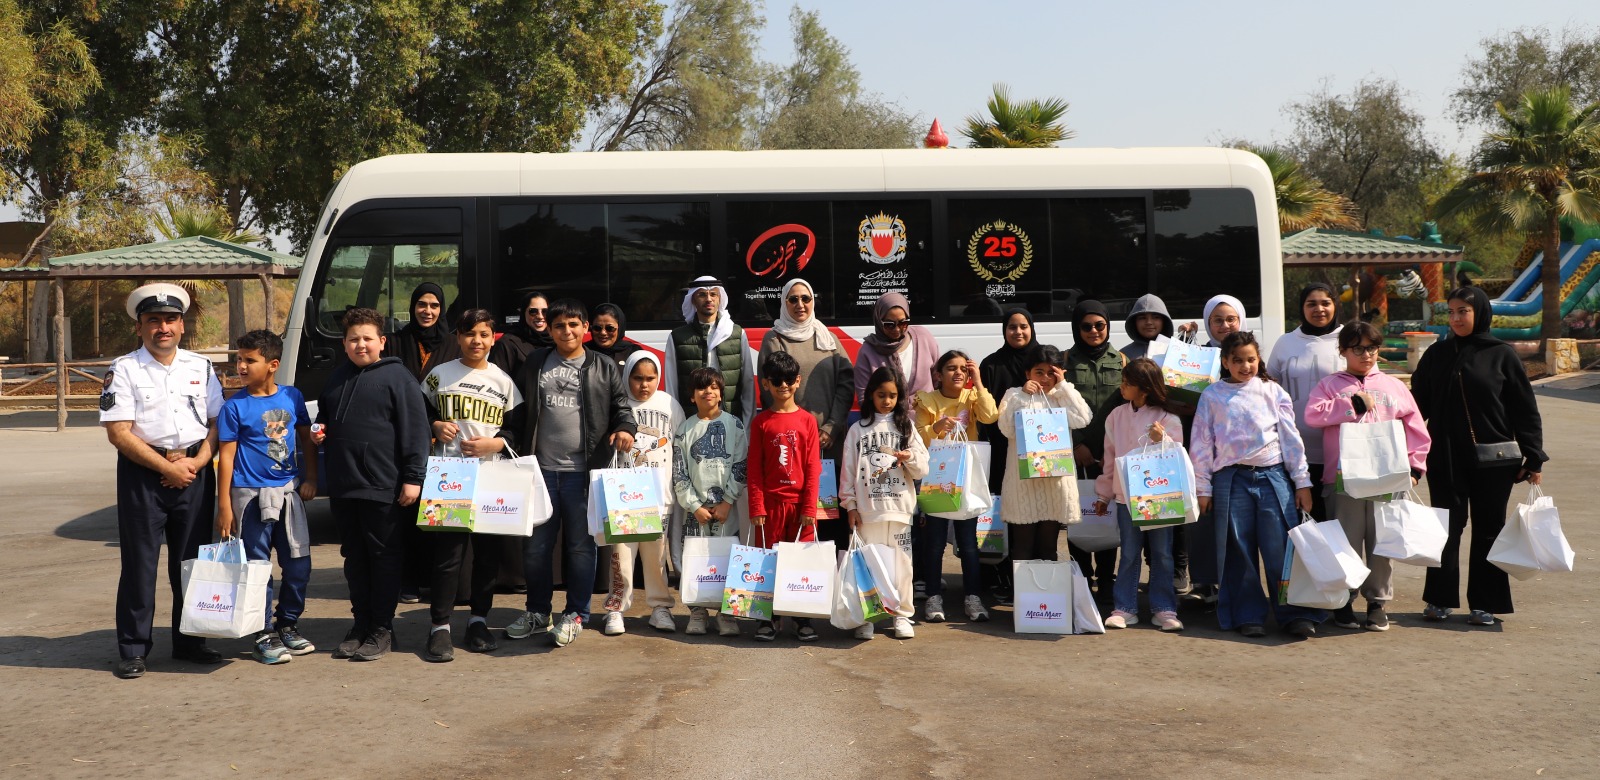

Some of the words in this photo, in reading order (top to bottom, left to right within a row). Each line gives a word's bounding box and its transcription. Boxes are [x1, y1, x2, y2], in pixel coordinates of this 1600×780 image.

[984, 236, 1017, 257] 25
[539, 367, 581, 391] AMERICA
[545, 395, 576, 408] EAGLE
[482, 505, 499, 513] MEGA
[500, 505, 518, 514] MART
[696, 574, 713, 582] MEGA
[714, 574, 727, 582] MA
[787, 583, 804, 591] MEGA
[805, 584, 824, 592] MART
[197, 601, 215, 610] MEGA
[215, 603, 233, 612] MART
[1025, 610, 1043, 619] MEGA
[1044, 611, 1062, 619] MART
